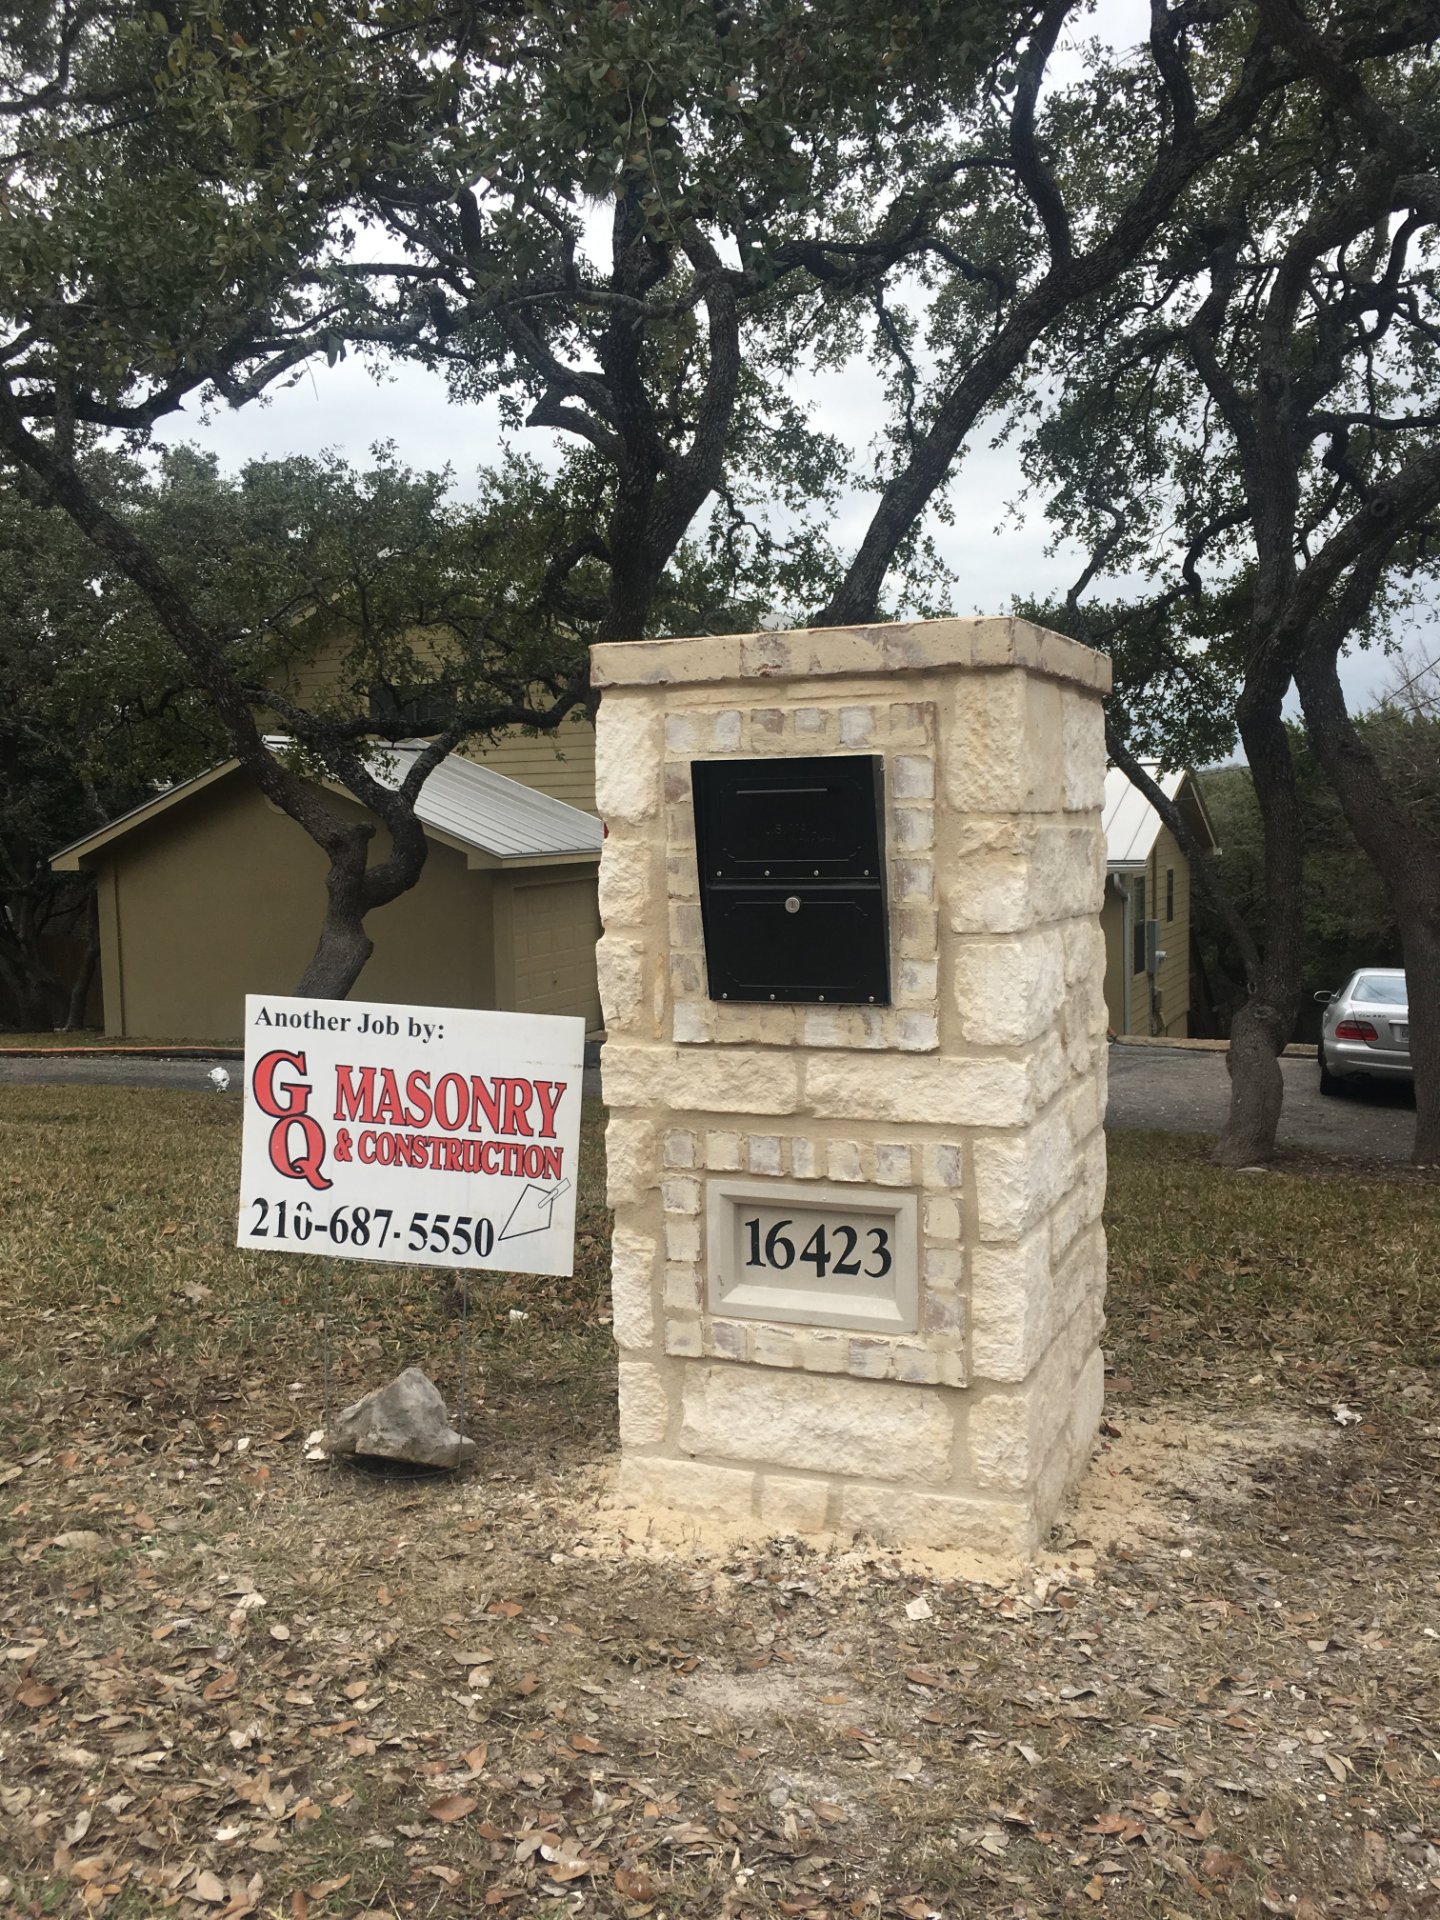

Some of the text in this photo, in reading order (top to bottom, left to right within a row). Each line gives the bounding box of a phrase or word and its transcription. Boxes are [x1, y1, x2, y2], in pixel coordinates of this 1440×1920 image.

[254, 1006, 445, 1044] Another Job by:
[333, 1064, 568, 1139] MASONRY
[333, 1127, 564, 1180] & CONSTRUCTION
[744, 1217, 892, 1279] 16423
